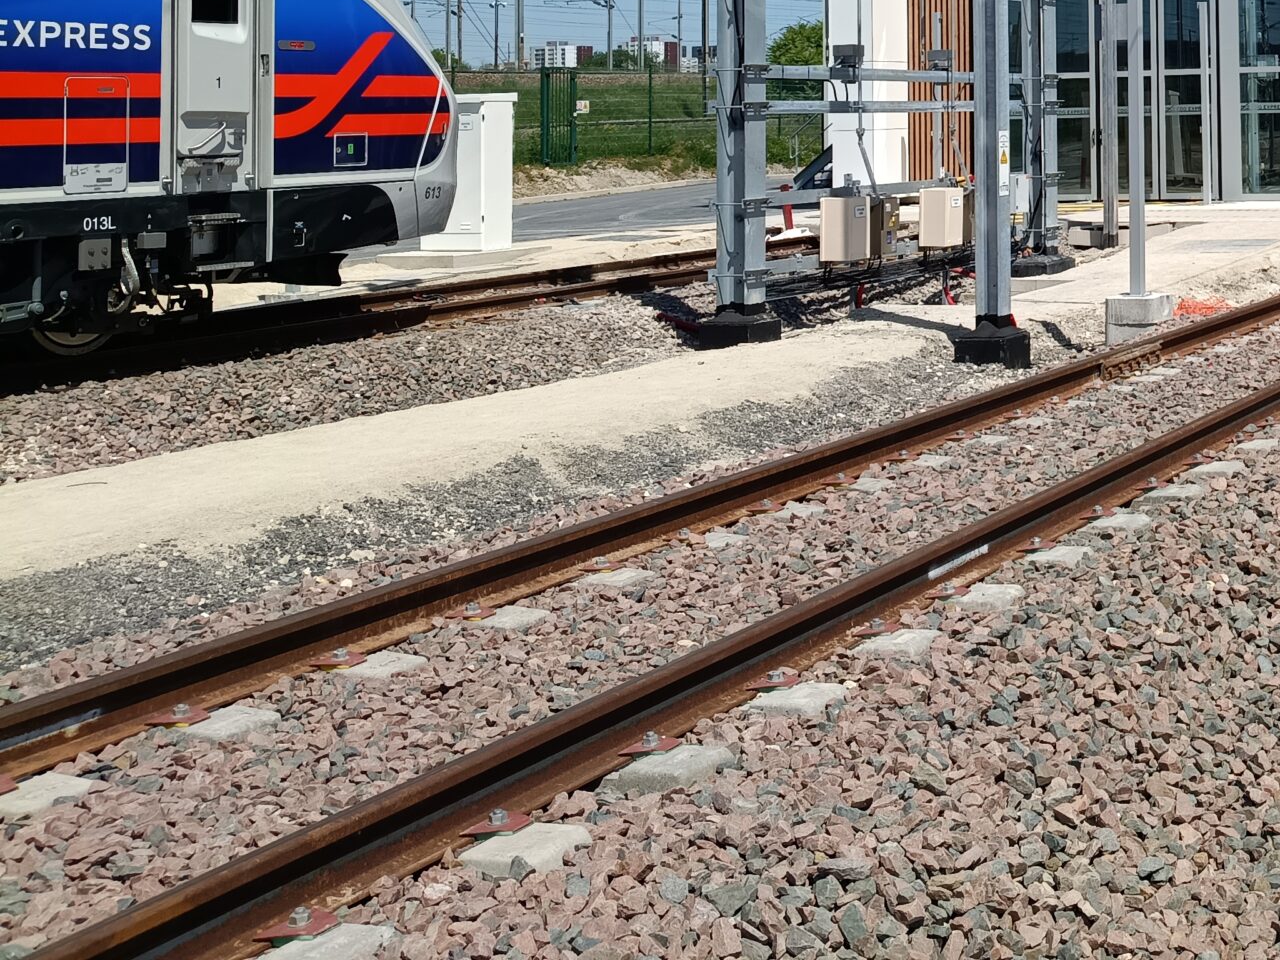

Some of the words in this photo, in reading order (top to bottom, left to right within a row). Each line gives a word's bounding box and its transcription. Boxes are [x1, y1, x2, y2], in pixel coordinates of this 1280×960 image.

[215, 76, 221, 89] 1
[424, 186, 442, 199] 613
[83, 215, 117, 231] 013L
